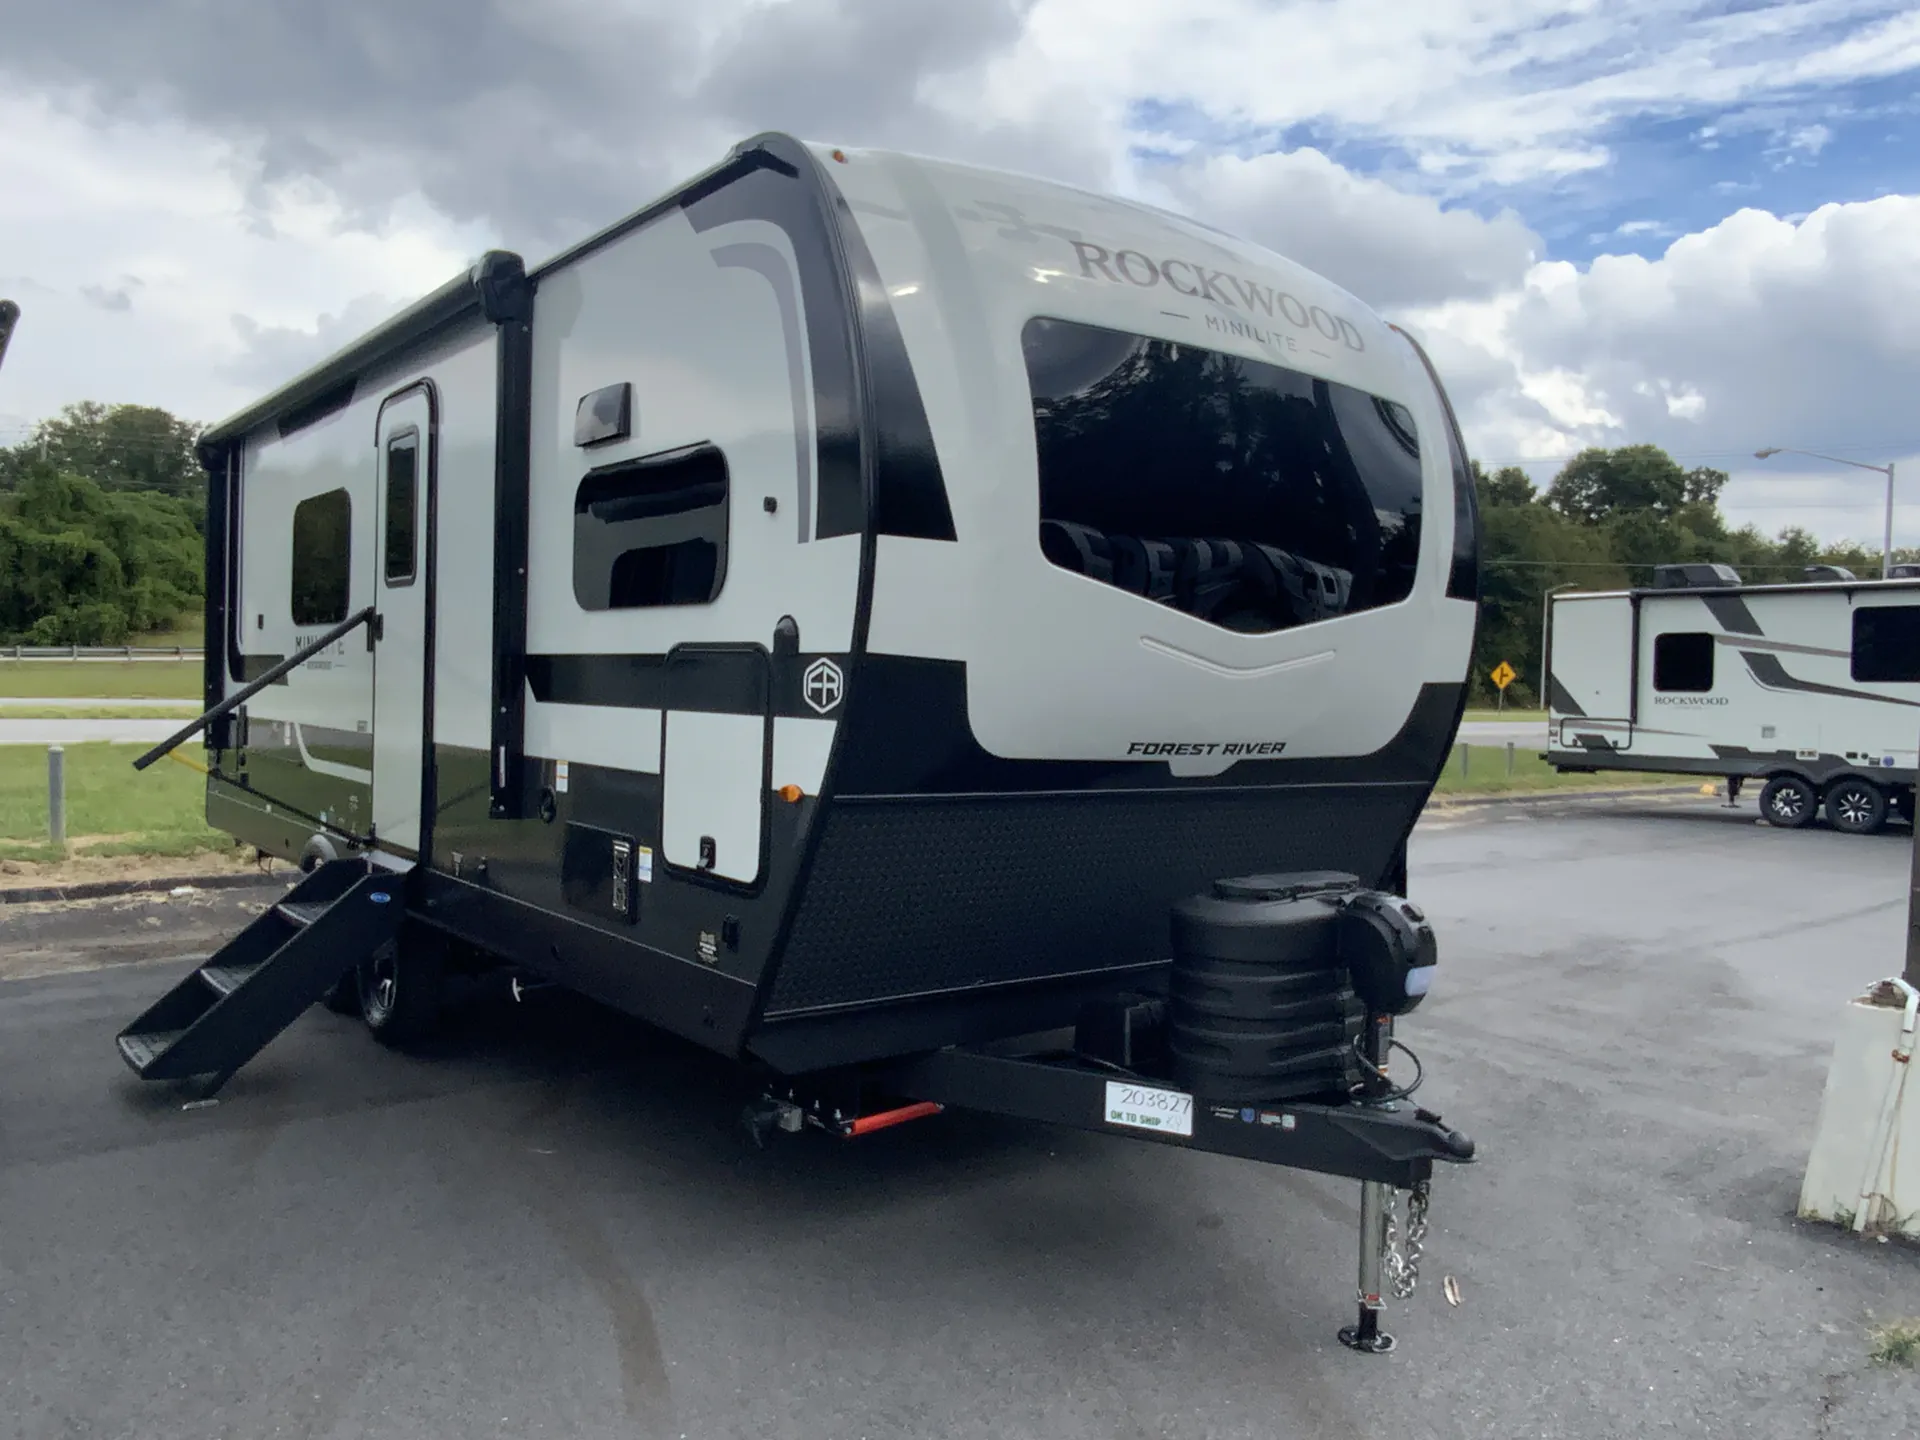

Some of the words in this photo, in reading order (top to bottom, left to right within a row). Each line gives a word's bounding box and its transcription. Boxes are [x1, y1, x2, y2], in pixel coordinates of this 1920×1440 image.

[1069, 240, 1365, 352] ROCKWOOD
[1205, 314, 1297, 352] MINILITE
[1654, 696, 1729, 706] ROCKWOOD
[1127, 742, 1220, 756] FOREST
[1221, 742, 1287, 756] RIVER
[1120, 1088, 1191, 1115] 203827
[1110, 1109, 1124, 1120] OK
[1126, 1112, 1137, 1122] TO
[1139, 1114, 1162, 1126] SHIP
